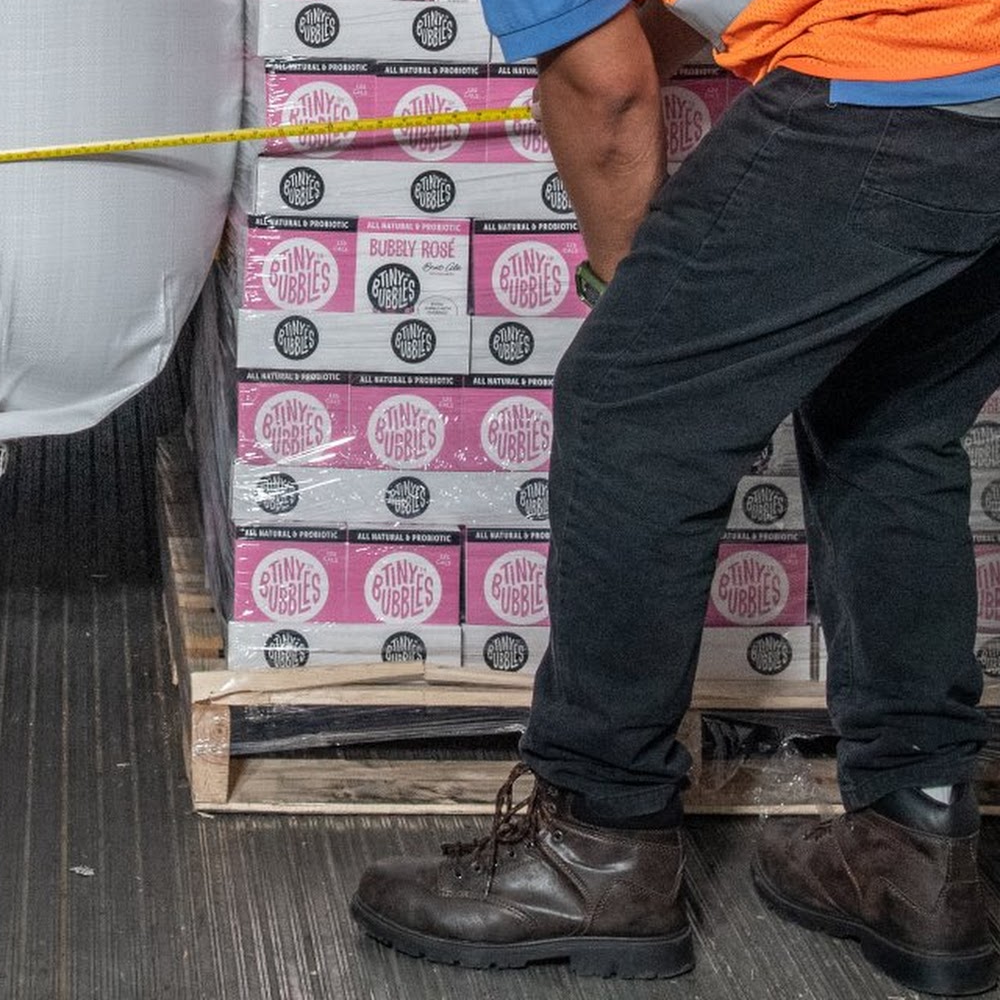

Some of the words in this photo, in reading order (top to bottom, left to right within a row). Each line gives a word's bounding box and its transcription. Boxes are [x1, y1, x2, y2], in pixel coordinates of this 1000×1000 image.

[305, 7, 329, 24] TINY
[422, 10, 446, 27] TINY
[300, 16, 336, 45] BUBBLES
[417, 19, 453, 48] BUBBLES
[275, 63, 288, 72] ALL
[288, 63, 320, 72] NATURAL
[328, 63, 368, 72] PROBIOTIC
[384, 66, 398, 74] ALL
[398, 66, 432, 75] NATURAL
[440, 67, 479, 76] PROBIOTIC
[498, 66, 510, 75] ALL
[284, 180, 320, 207] BUBBLES
[290, 172, 312, 188] TINY
[420, 174, 445, 190] TINY
[414, 183, 452, 210] BUBBLES
[255, 218, 268, 226] ALL
[269, 218, 304, 229] NATURAL
[310, 220, 349, 229] PROBIOTIC
[367, 221, 381, 230] ALL
[382, 222, 413, 231] NATURAL
[422, 223, 461, 232] PROBIOTIC
[484, 223, 496, 231] ALL
[498, 223, 530, 231] NATURAL
[532, 223, 538, 231] &
[539, 223, 578, 231] PROBIOTIC
[279, 245, 316, 274] TINY
[369, 238, 417, 258] BUBBLY
[421, 237, 455, 259] ROSÉ
[508, 248, 547, 277] TINY
[270, 259, 331, 305] BUBBLES
[378, 268, 404, 288] TINY
[500, 262, 562, 309] BUBBLES
[372, 279, 416, 308] BUBBLES
[284, 318, 308, 335] TINY
[400, 322, 426, 339] TINY
[498, 324, 524, 341] TINY
[278, 327, 315, 357] BUBBLES
[395, 331, 432, 360] BUBBLES
[493, 333, 530, 362] BUBBLES
[246, 372, 260, 380] ALL
[260, 372, 293, 381] NATURAL
[301, 373, 341, 382] PROBIOTIC
[360, 375, 373, 384] ALL
[374, 376, 407, 384] NATURAL
[415, 377, 454, 386] PROBIOTIC
[473, 377, 486, 386] ALL
[487, 377, 520, 386] NATURAL
[271, 399, 307, 427] TINY
[385, 402, 421, 430] TINY
[498, 403, 533, 431] TINY
[262, 413, 323, 459] BUBBLES
[375, 416, 437, 463] BUBBLES
[488, 418, 550, 463] BUBBLES
[397, 478, 420, 495] TINY
[390, 488, 427, 516] BUBBLES
[244, 529, 258, 538] ALL
[258, 530, 291, 539] NATURAL
[298, 531, 338, 540] PROBIOTIC
[357, 533, 371, 541] ALL
[372, 534, 403, 542] NATURAL
[412, 534, 452, 544] PROBIOTIC
[476, 532, 488, 540] ALL
[489, 532, 522, 540] NATURAL
[268, 556, 304, 584] TINY
[381, 558, 417, 585] TINY
[500, 558, 536, 586] TINY
[728, 560, 764, 587] TINY
[259, 571, 321, 617] BUBBLES
[372, 574, 434, 620] BUBBLES
[492, 572, 544, 618] BUBBLE
[718, 573, 781, 618] BUBBLES
[394, 635, 418, 651] TINY
[494, 635, 519, 652] TINY
[487, 644, 525, 671] BUBBLES
